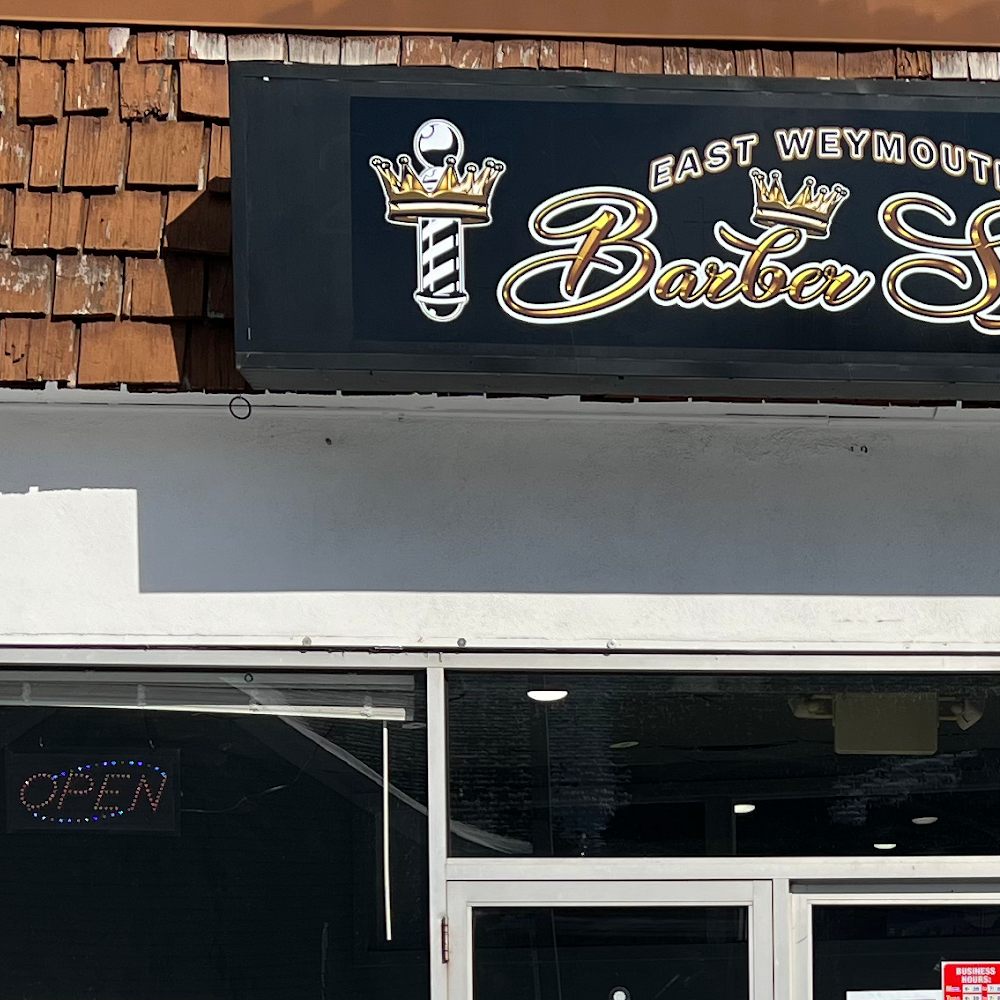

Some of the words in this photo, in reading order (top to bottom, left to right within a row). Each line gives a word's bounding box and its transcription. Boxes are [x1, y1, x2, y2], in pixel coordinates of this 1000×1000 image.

[649, 133, 760, 194] EAST
[497, 186, 876, 325] Barber
[19, 771, 169, 813] OPEN
[955, 966, 997, 976] BUSINESS
[961, 975, 993, 984] HOURS:
